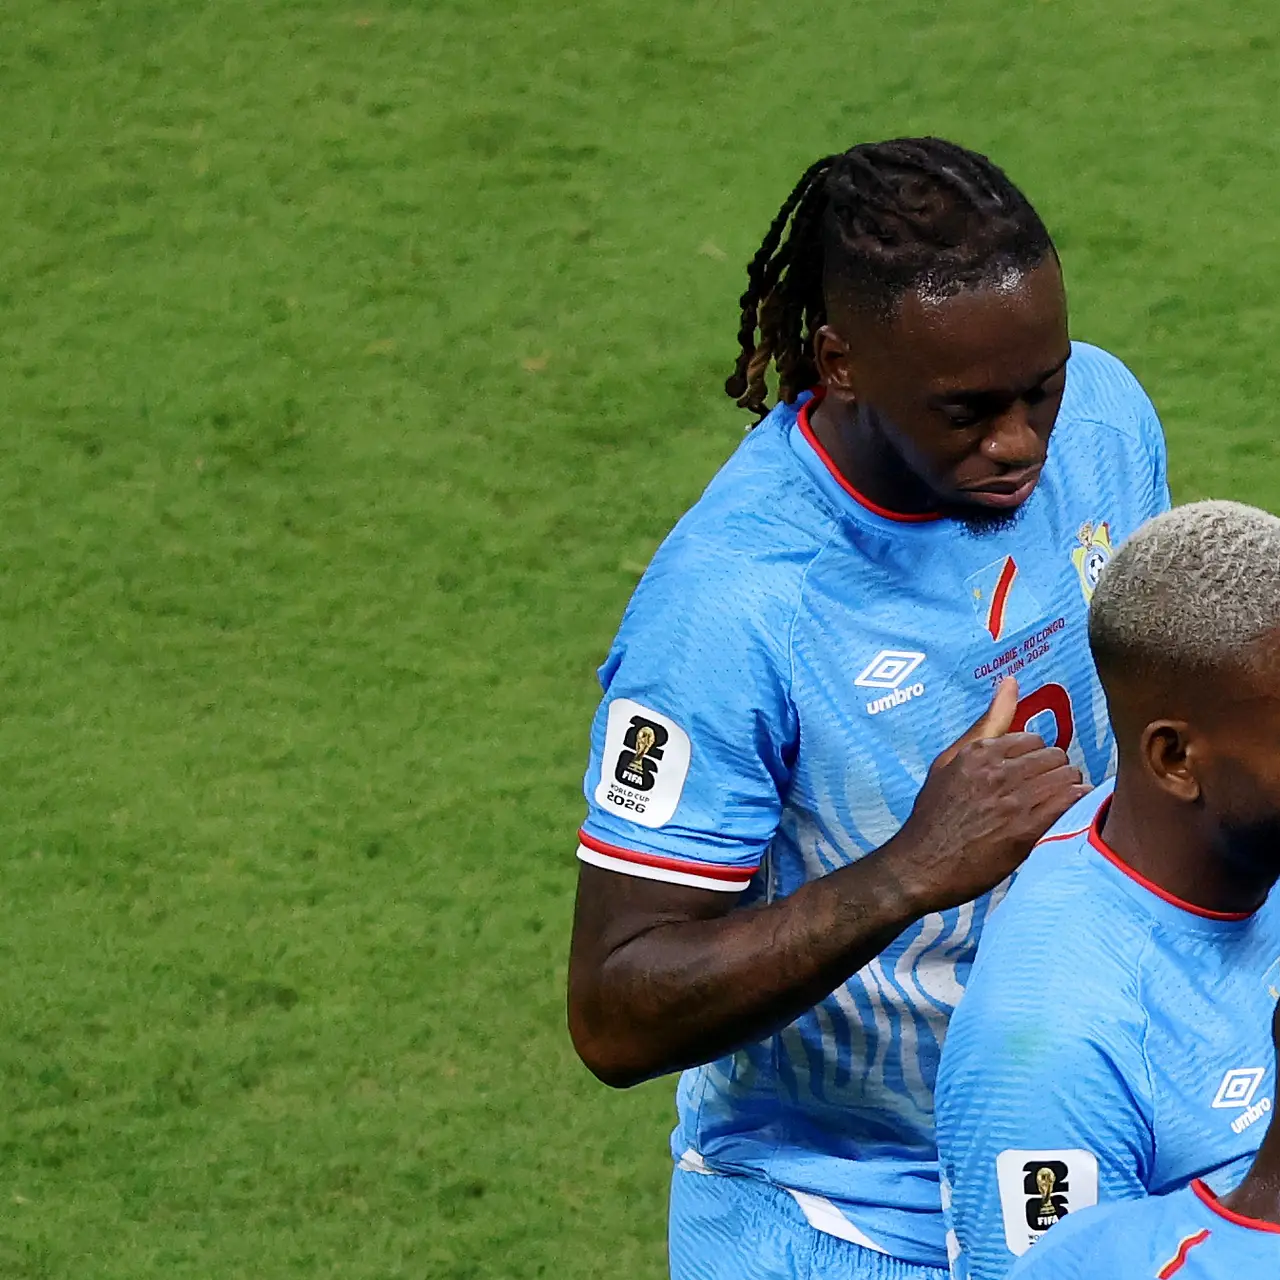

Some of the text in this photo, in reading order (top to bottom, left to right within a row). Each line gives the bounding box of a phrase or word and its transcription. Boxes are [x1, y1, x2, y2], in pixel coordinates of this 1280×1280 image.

[973, 646, 1018, 680] COLOMBIE
[866, 682, 925, 715] umbro
[621, 770, 643, 786] FIFA
[606, 790, 646, 814] 2026
[611, 783, 650, 803] WORLD CUP
[1230, 1097, 1271, 1134] umbro
[1036, 1214, 1059, 1226] FIFA
